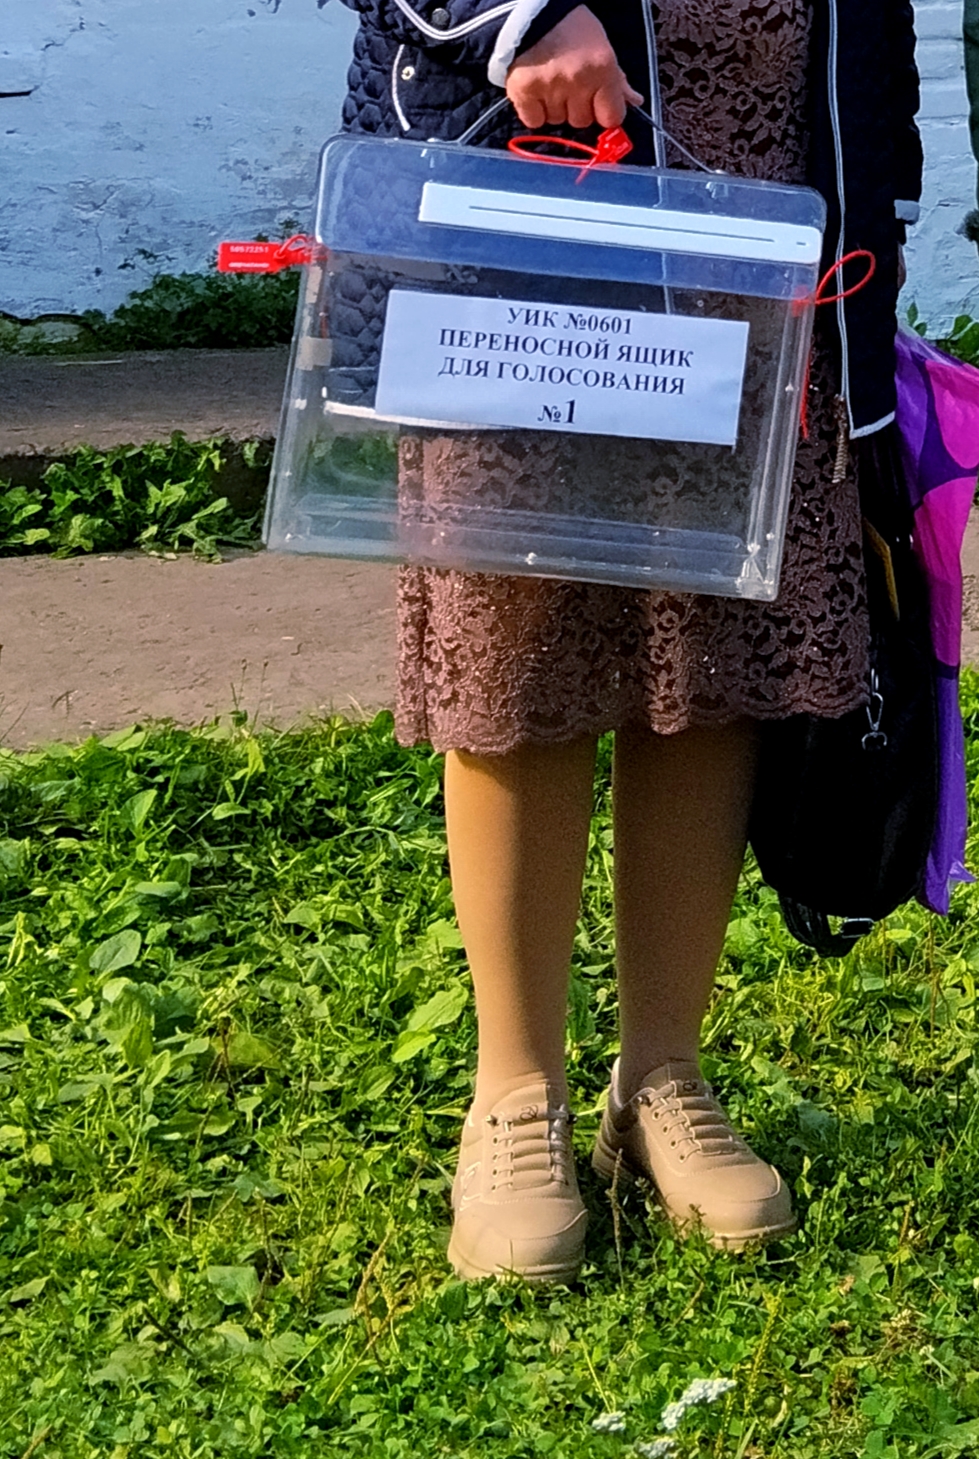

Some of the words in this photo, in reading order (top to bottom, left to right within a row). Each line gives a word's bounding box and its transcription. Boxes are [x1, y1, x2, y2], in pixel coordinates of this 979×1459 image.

[507, 307, 558, 328] УИК
[563, 312, 632, 335] №0601
[438, 328, 610, 361] ПЕРЕНОСНОЙ
[616, 345, 694, 369] ЯЩИК
[438, 357, 489, 378] ДЛЯ
[496, 361, 685, 395] ГОЛОСОВАНИЯ
[537, 399, 576, 425] №1
